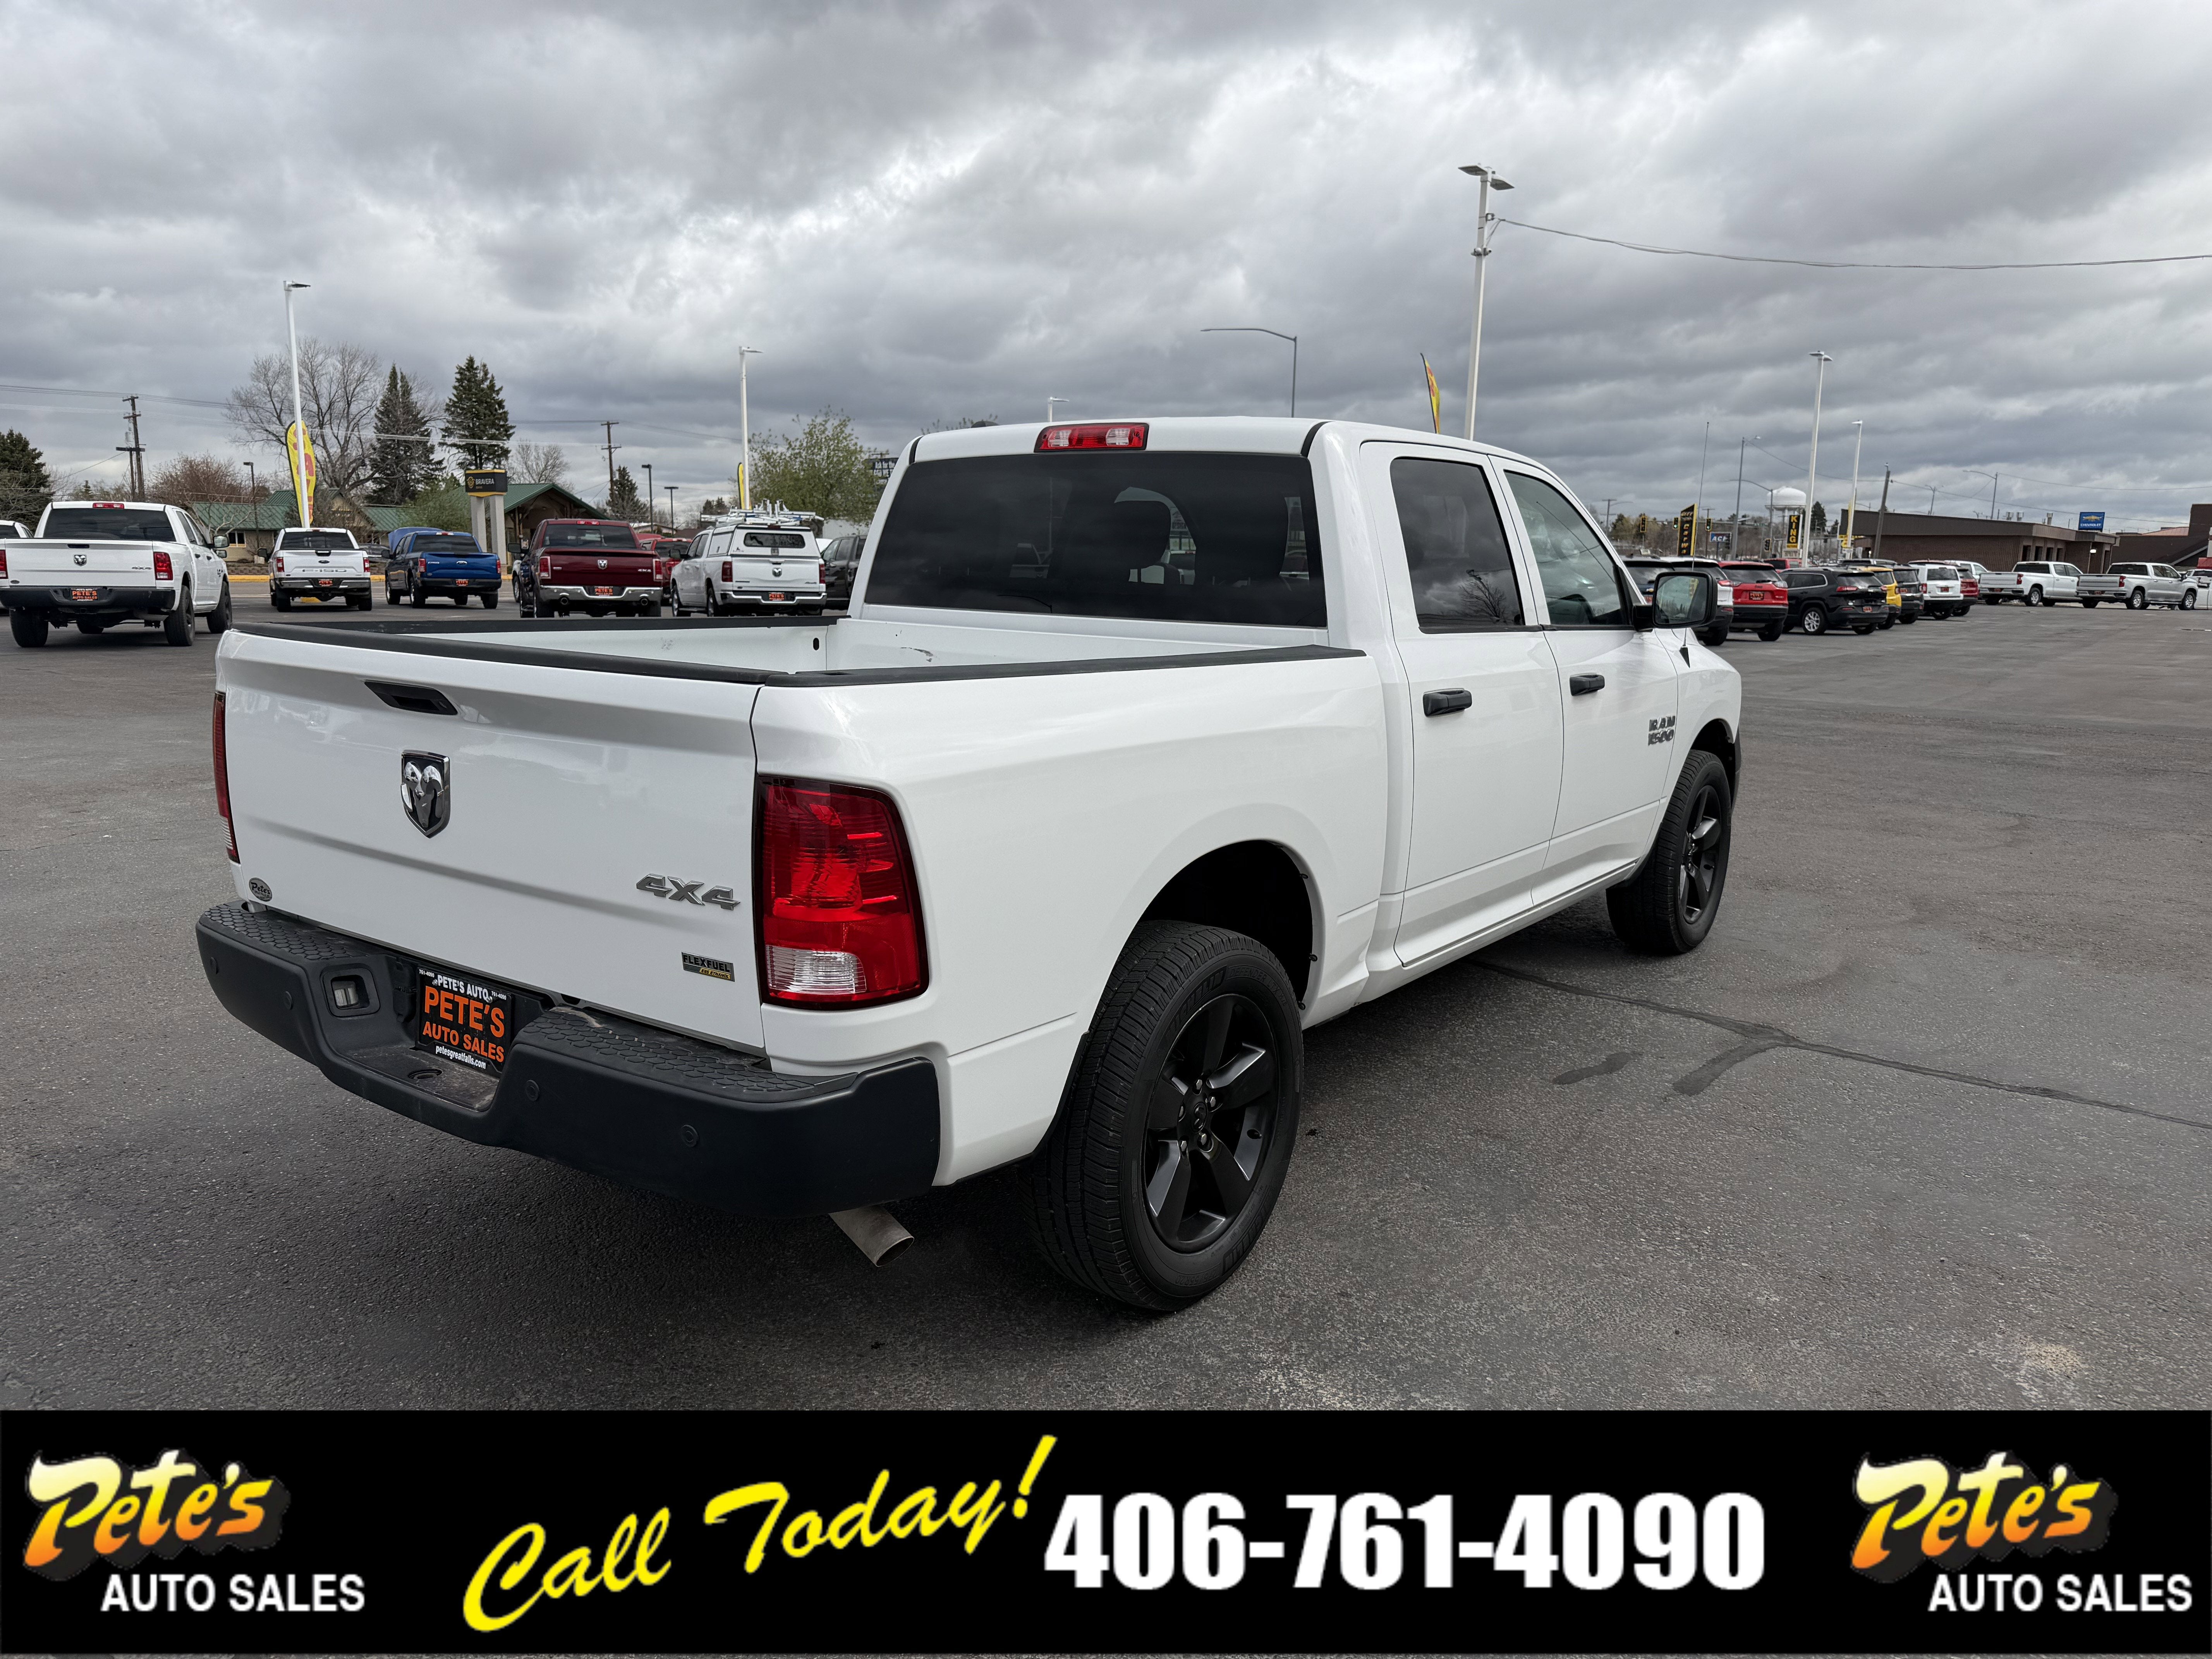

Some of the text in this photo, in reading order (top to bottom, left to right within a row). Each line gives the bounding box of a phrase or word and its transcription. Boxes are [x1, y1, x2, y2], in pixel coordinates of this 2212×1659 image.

[1790, 516, 1798, 543] KING
[1648, 729, 1674, 746] 1500
[437, 974, 489, 1001] PETE'S AUTO
[710, 970, 729, 979] ETHANOL
[425, 986, 504, 1038] PETE'S
[422, 1021, 504, 1063] AUTO SALES
[436, 1045, 486, 1070] petesgreatfalls.com
